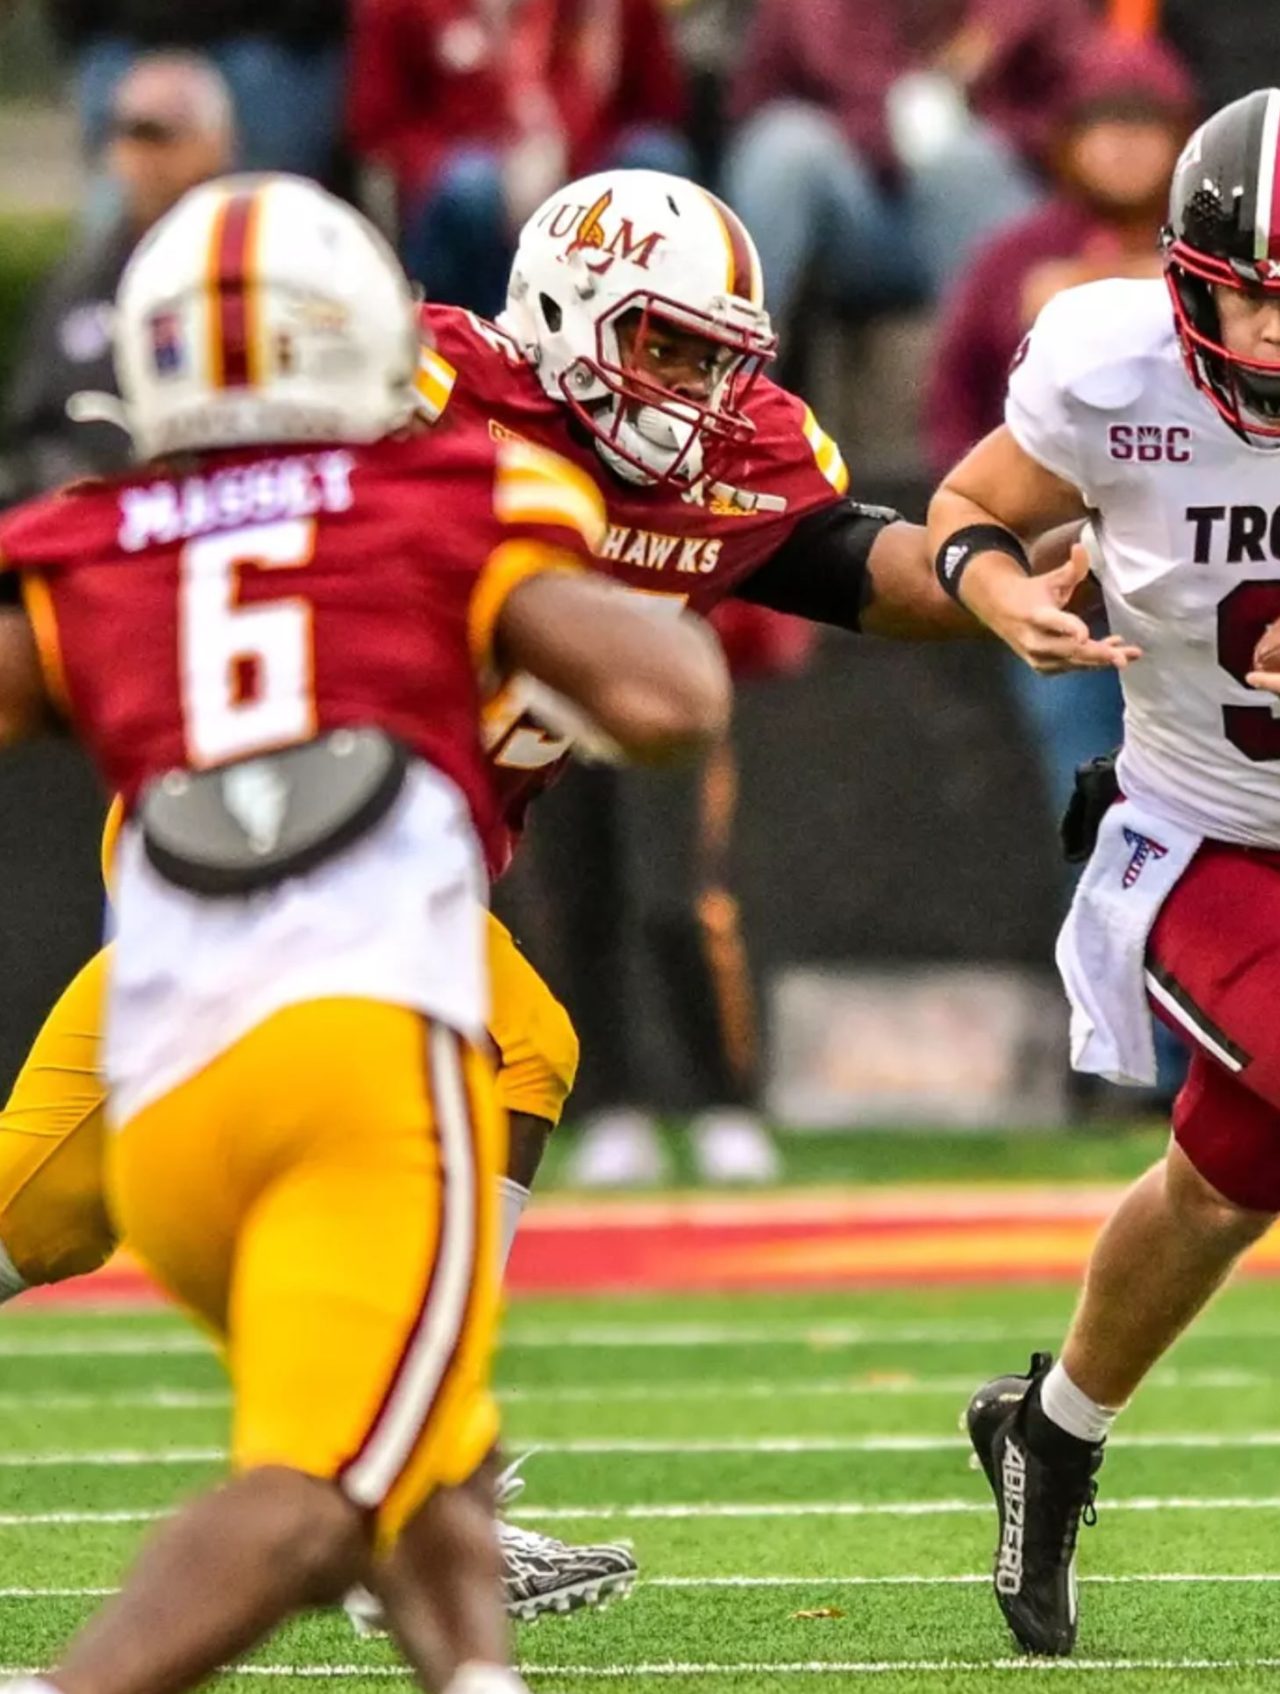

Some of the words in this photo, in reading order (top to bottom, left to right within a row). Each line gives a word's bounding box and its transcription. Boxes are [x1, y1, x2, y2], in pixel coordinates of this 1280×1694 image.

[1109, 424, 1191, 463] SBC
[601, 525, 723, 573] HAWKS
[179, 520, 316, 769] 6
[995, 1436, 1027, 1595] ADIZERO
